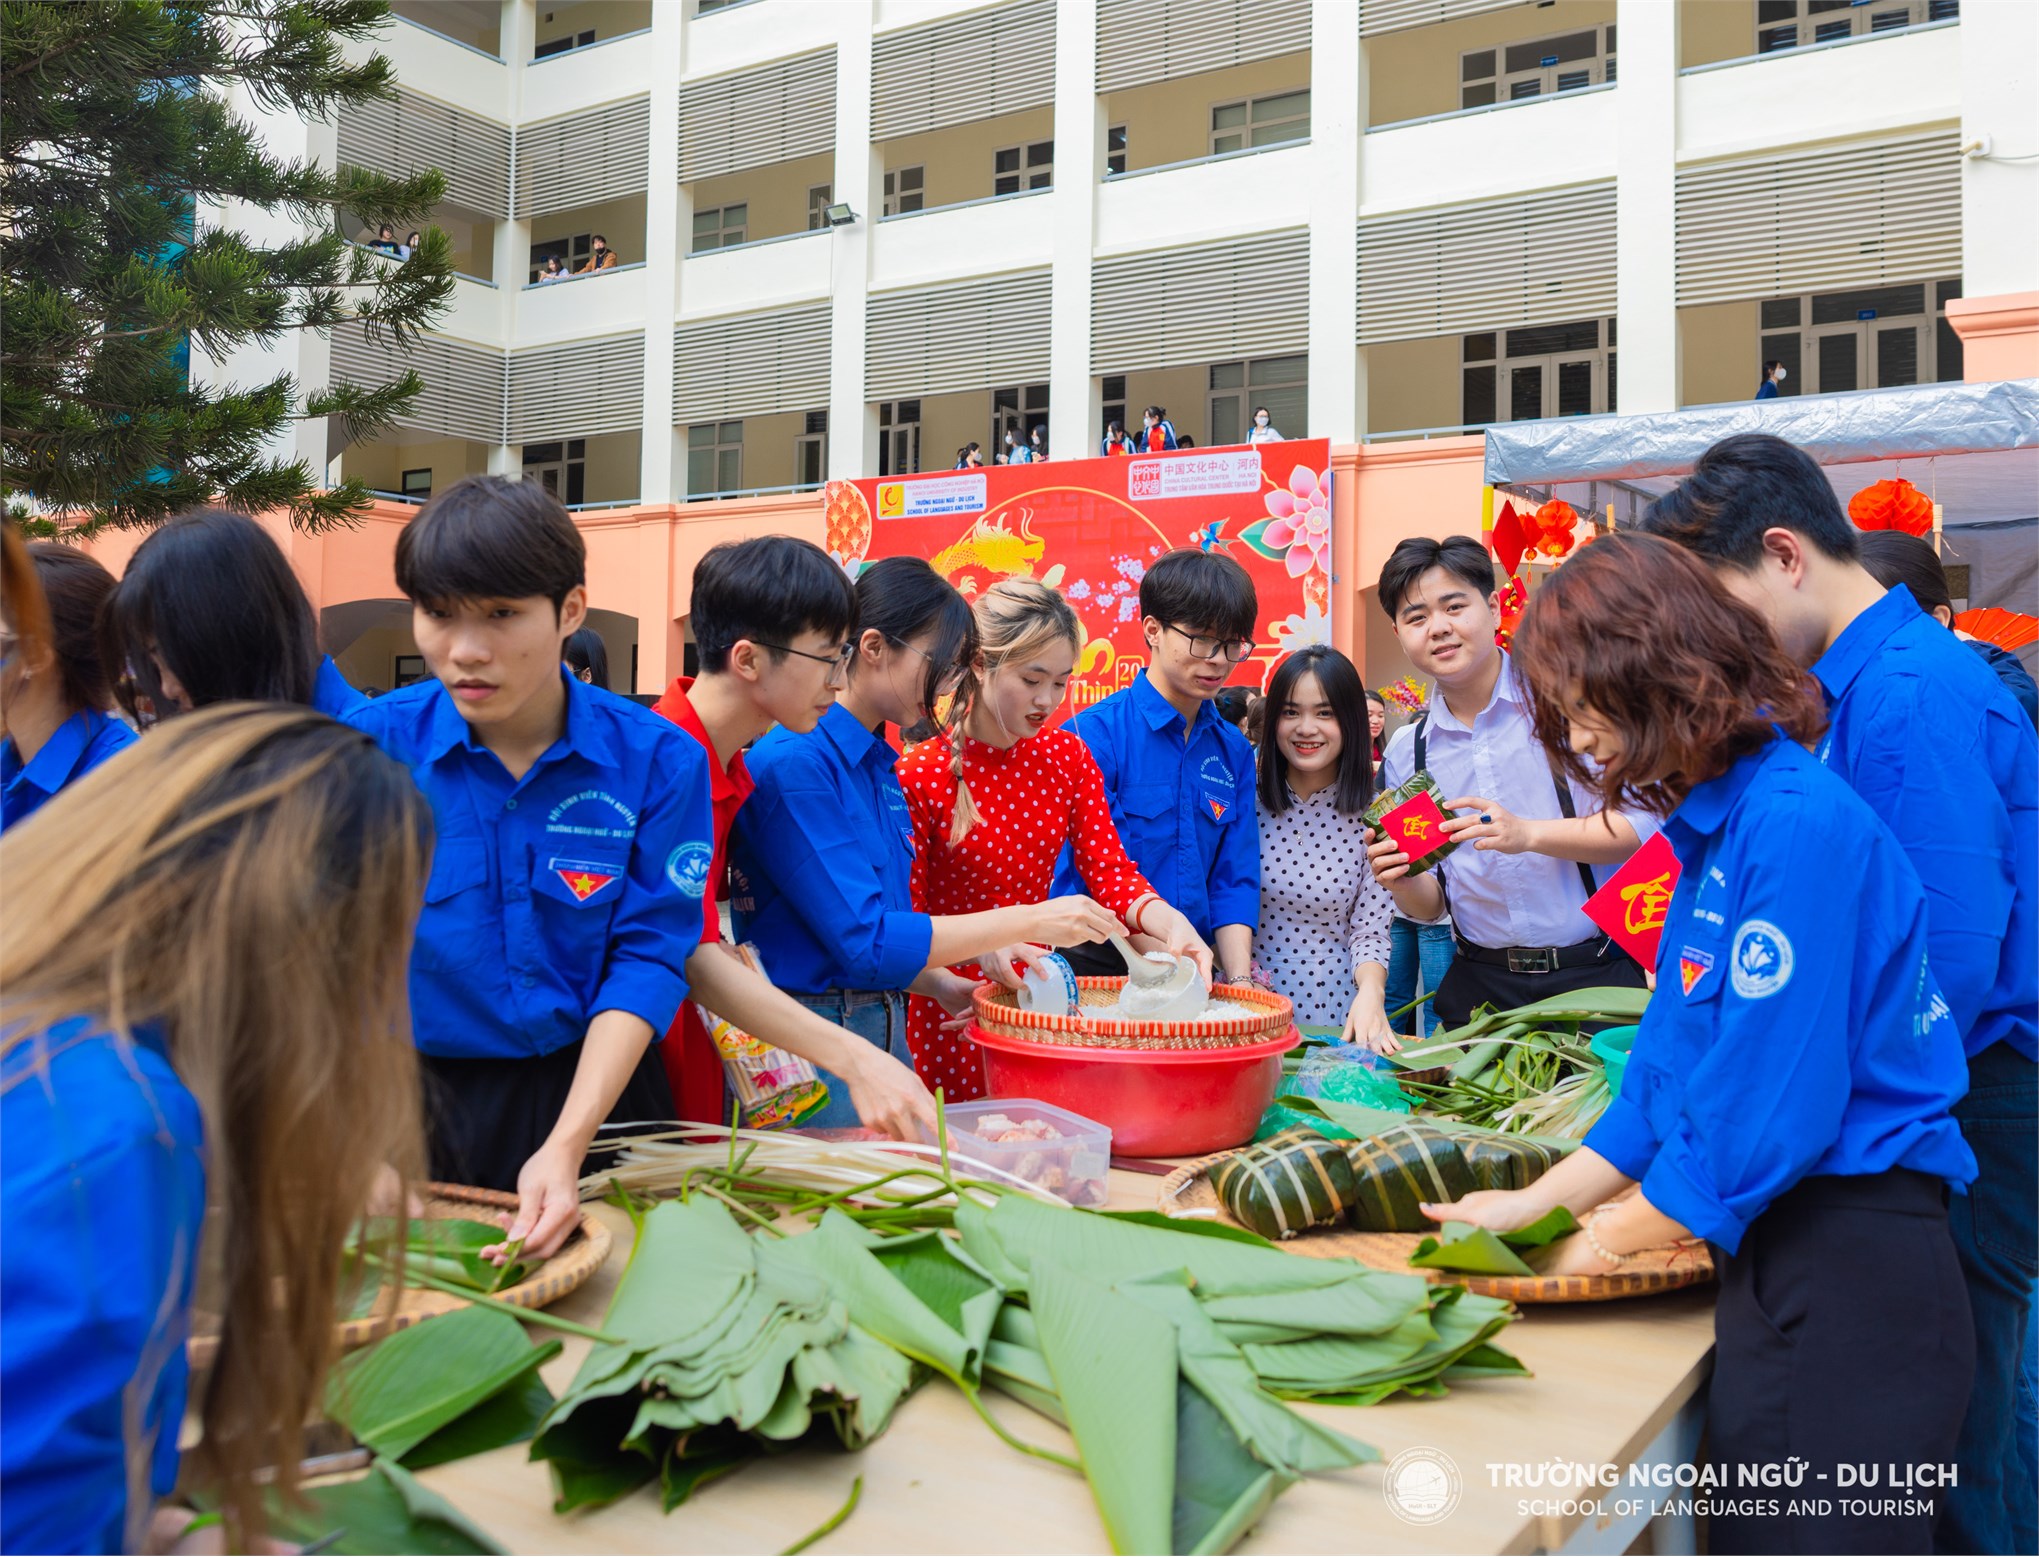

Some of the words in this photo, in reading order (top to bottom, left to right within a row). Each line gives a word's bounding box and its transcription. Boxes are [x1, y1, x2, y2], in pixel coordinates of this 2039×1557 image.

[1164, 460, 1229, 476] 中国文化中心
[1237, 457, 1259, 470] 河内
[907, 507, 923, 516] SCHOOL
[930, 504, 954, 514] LANGUAGES
[954, 503, 964, 511] AND
[964, 502, 984, 511] TOURISM
[1069, 679, 1114, 704] Thìn
